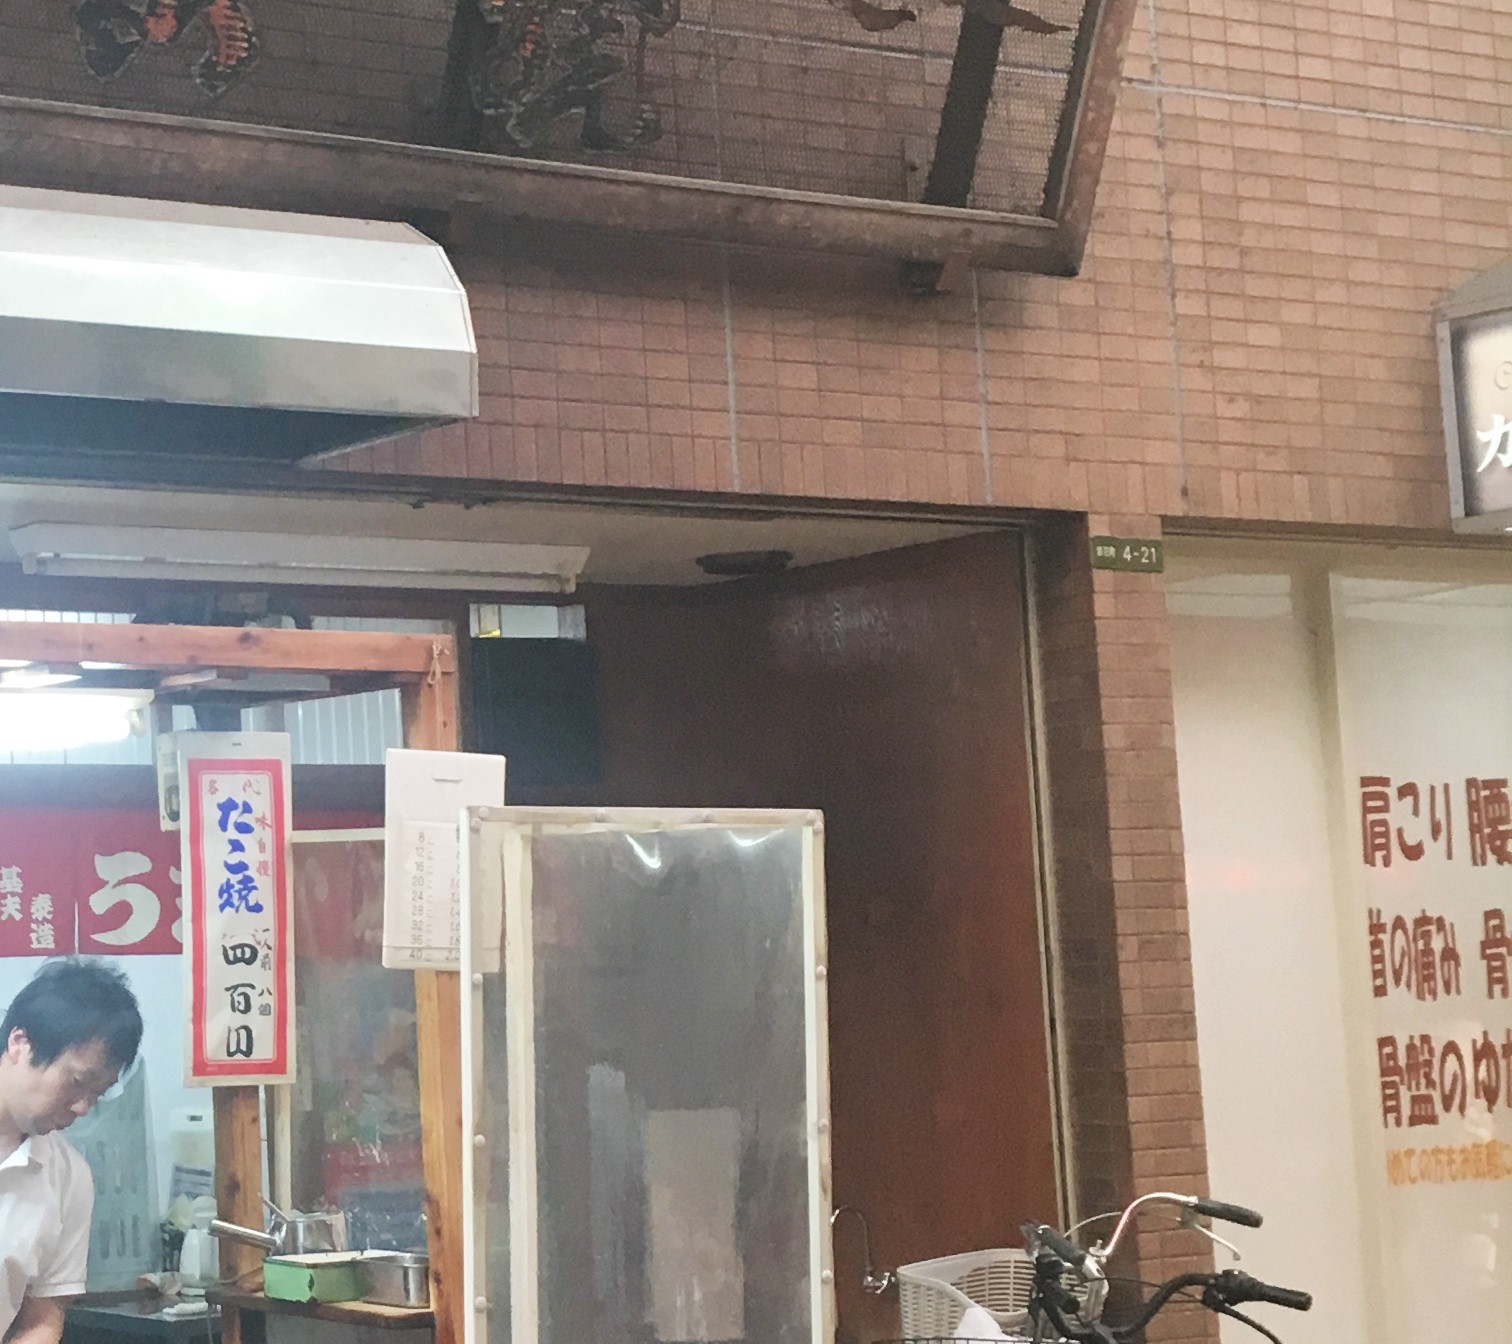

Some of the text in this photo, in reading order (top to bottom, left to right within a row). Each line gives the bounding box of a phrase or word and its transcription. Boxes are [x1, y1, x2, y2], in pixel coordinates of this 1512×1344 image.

[1123, 545, 1157, 564] 4-21
[216, 797, 264, 914] たこ焼
[1360, 775, 1454, 868] 肩こり
[1368, 907, 1461, 1001] 首の痛み
